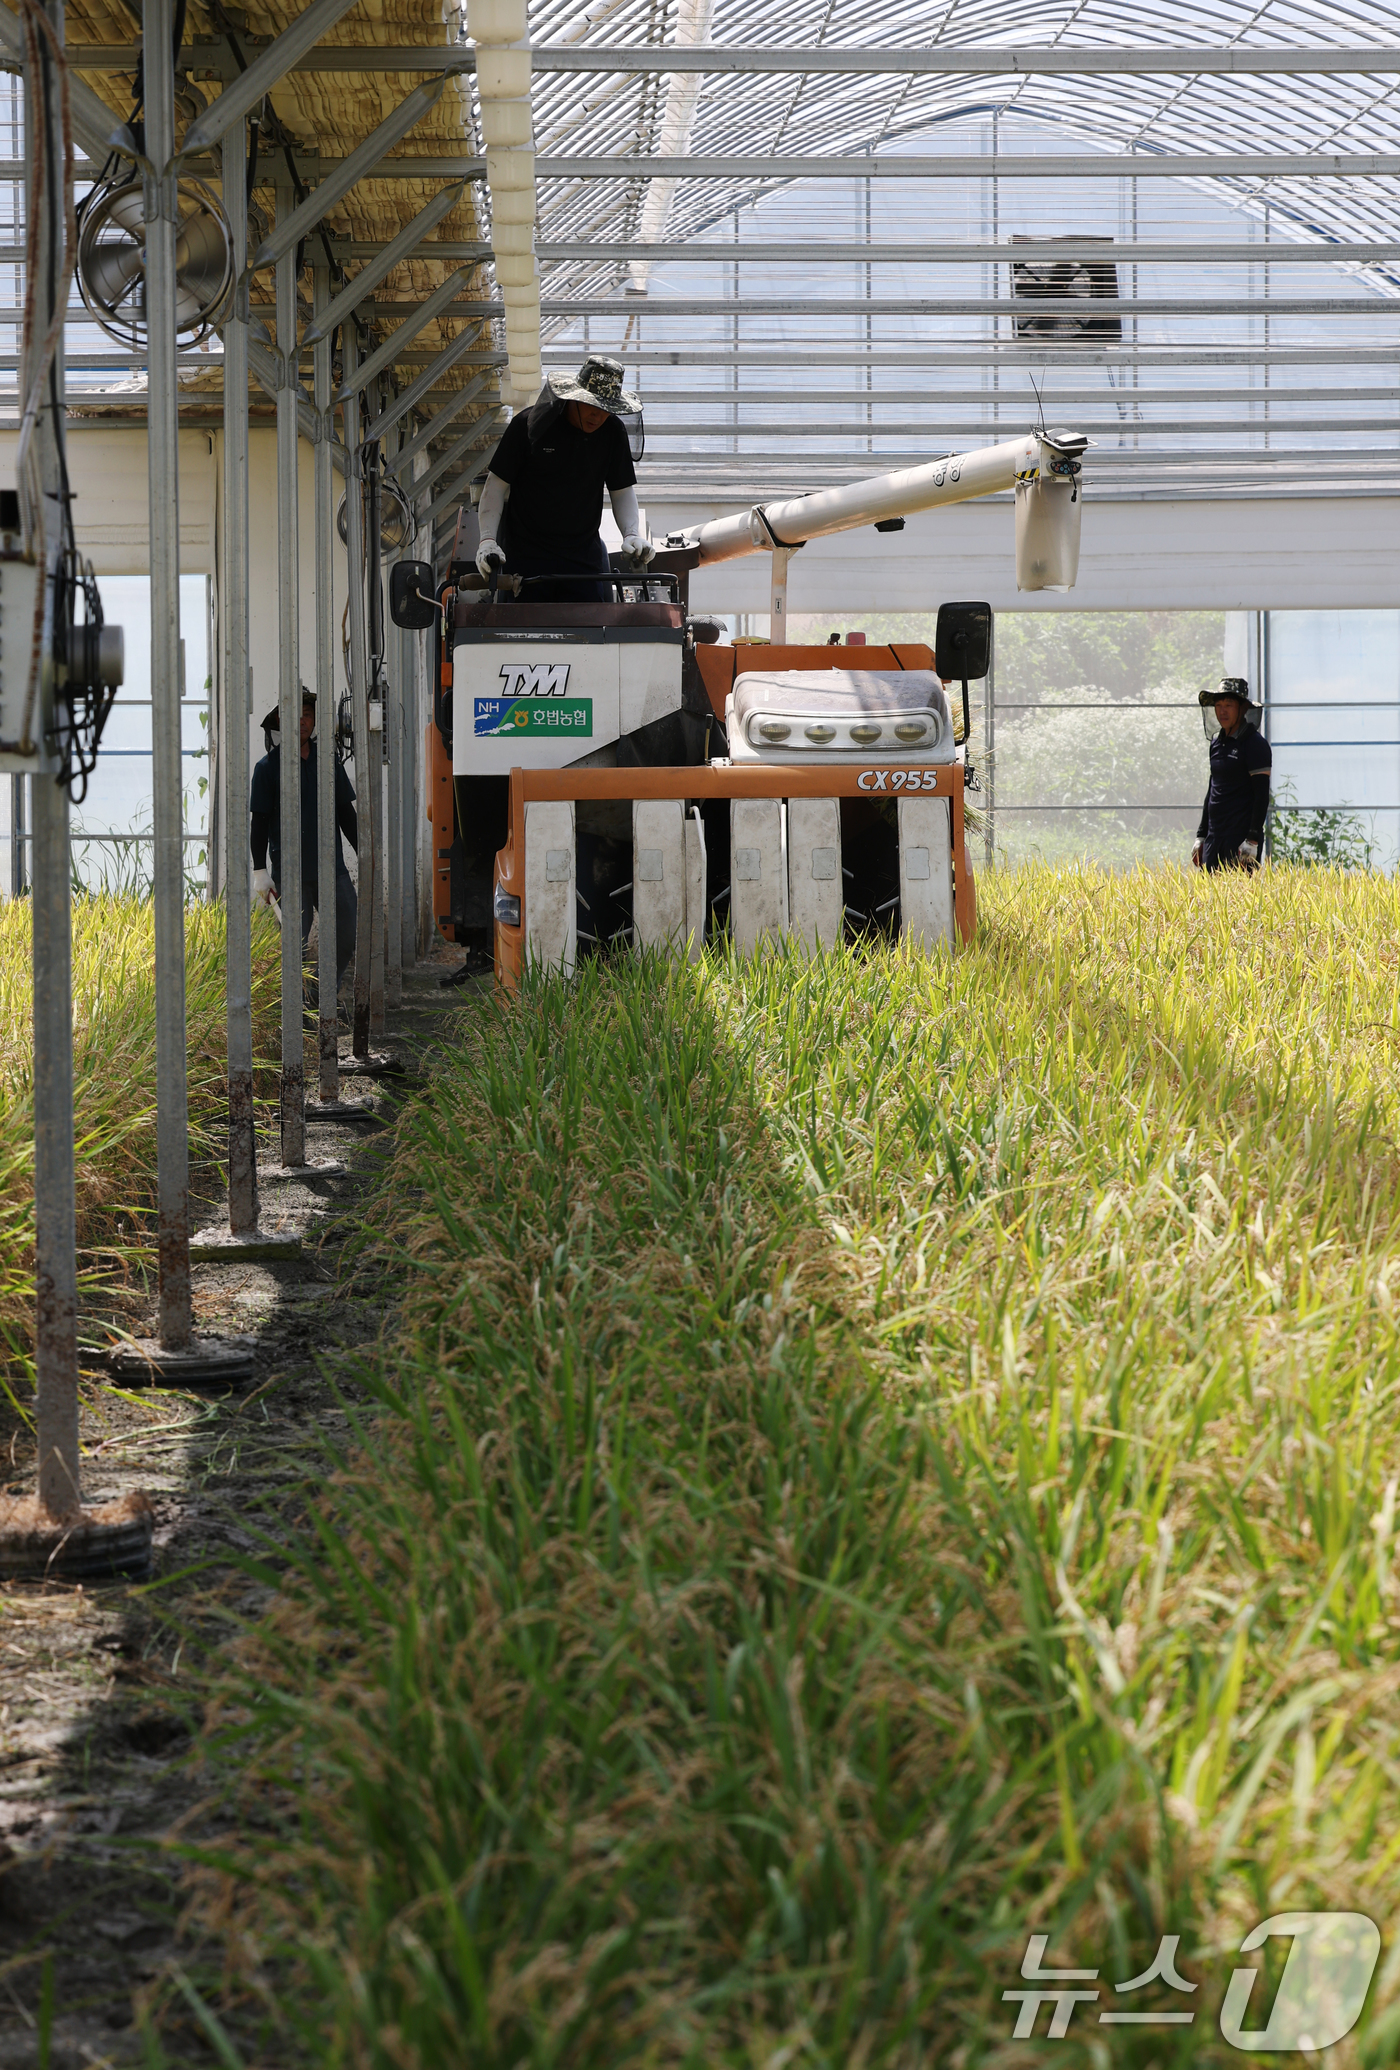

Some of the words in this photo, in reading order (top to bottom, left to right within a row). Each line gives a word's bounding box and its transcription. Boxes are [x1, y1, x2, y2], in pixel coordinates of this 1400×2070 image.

[499, 664, 571, 696] TYM
[478, 702, 499, 713] NH
[533, 709, 586, 726] 호법농협
